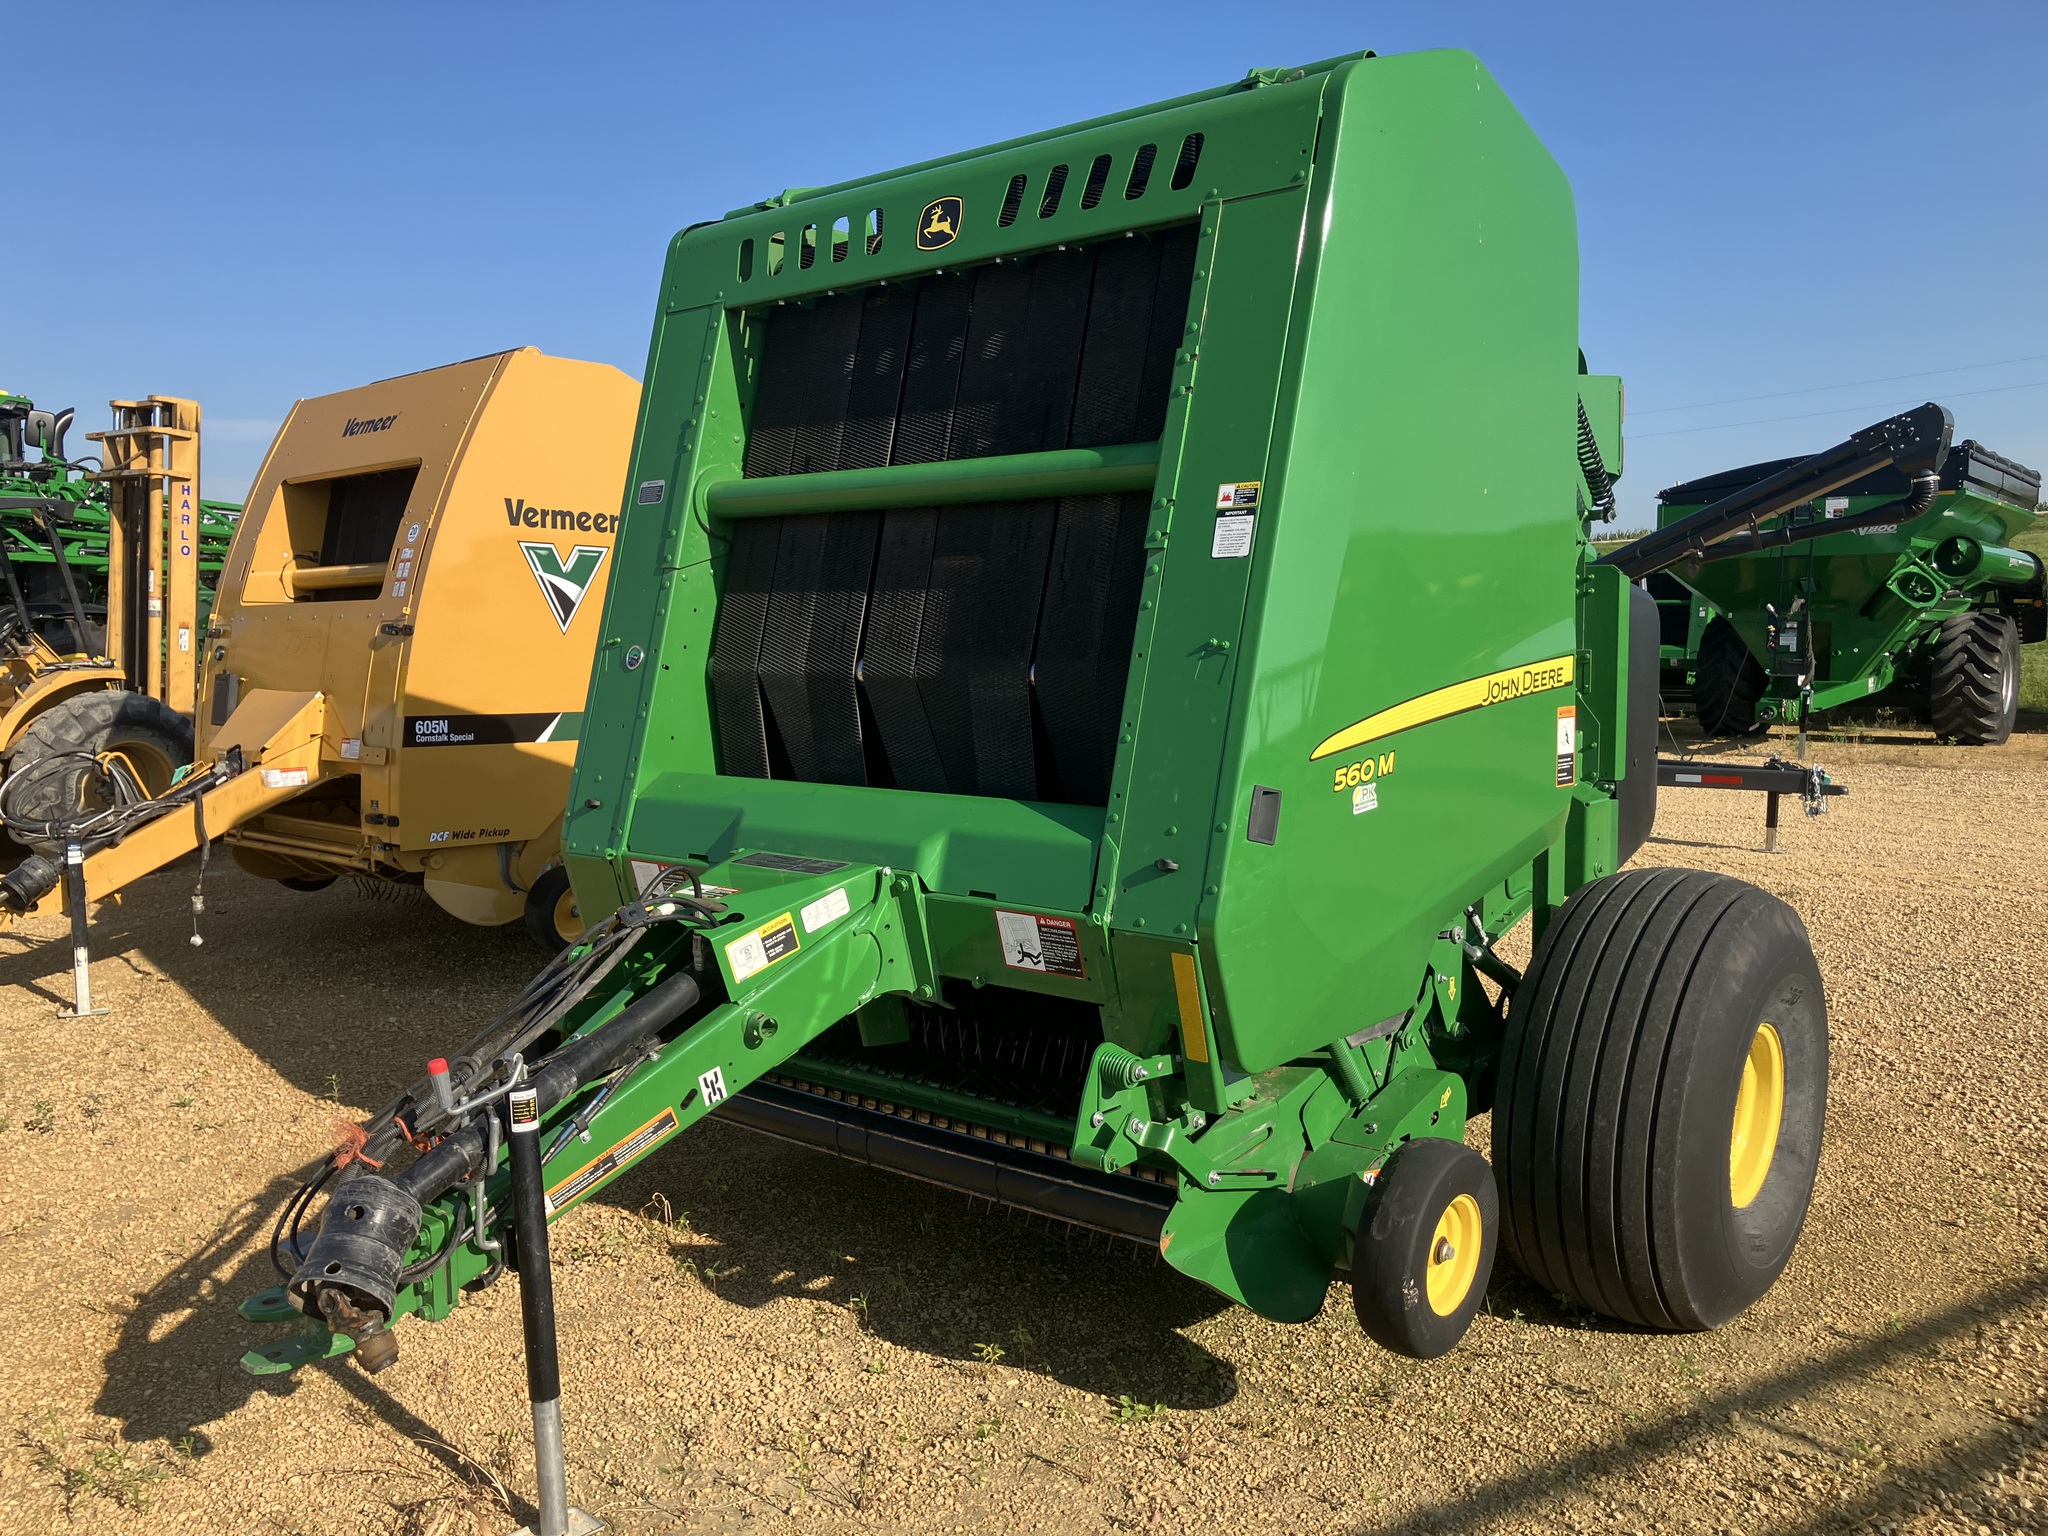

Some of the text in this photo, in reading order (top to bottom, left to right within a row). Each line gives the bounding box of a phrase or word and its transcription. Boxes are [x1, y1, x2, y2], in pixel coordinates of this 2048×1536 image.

[342, 414, 399, 438] Vermeer
[181, 484, 191, 556] HARLO
[503, 497, 619, 534] Vermeer
[1482, 666, 1564, 703] JOHN DEERE
[415, 719, 449, 735] 605N
[415, 732, 475, 743] Cornstalk Special
[1333, 750, 1396, 793] 560 M
[429, 827, 511, 843] DCF Wide Pickup
[766, 917, 788, 932] CAUTION
[1046, 919, 1072, 928] DANGER
